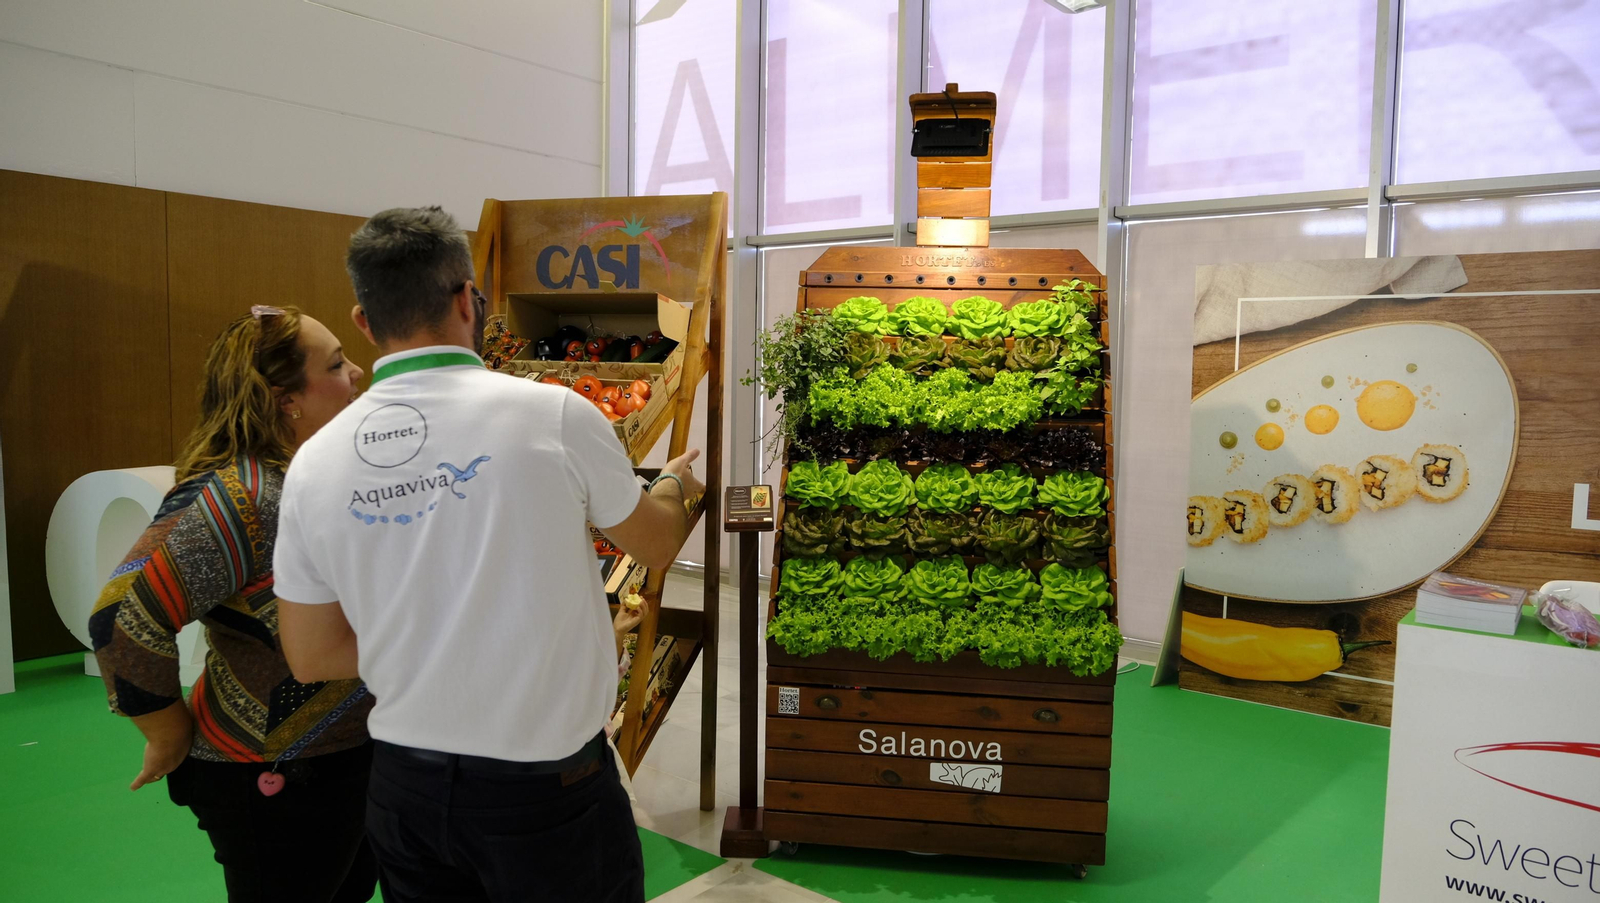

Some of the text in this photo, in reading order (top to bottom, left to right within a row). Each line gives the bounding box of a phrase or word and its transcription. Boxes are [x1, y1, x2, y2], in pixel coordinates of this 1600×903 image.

[536, 244, 640, 289] CASI
[362, 426, 418, 445] Hortet.
[350, 474, 449, 508] Aquaviva
[858, 728, 1003, 761] Salanova
[1445, 818, 1600, 894] Sweet
